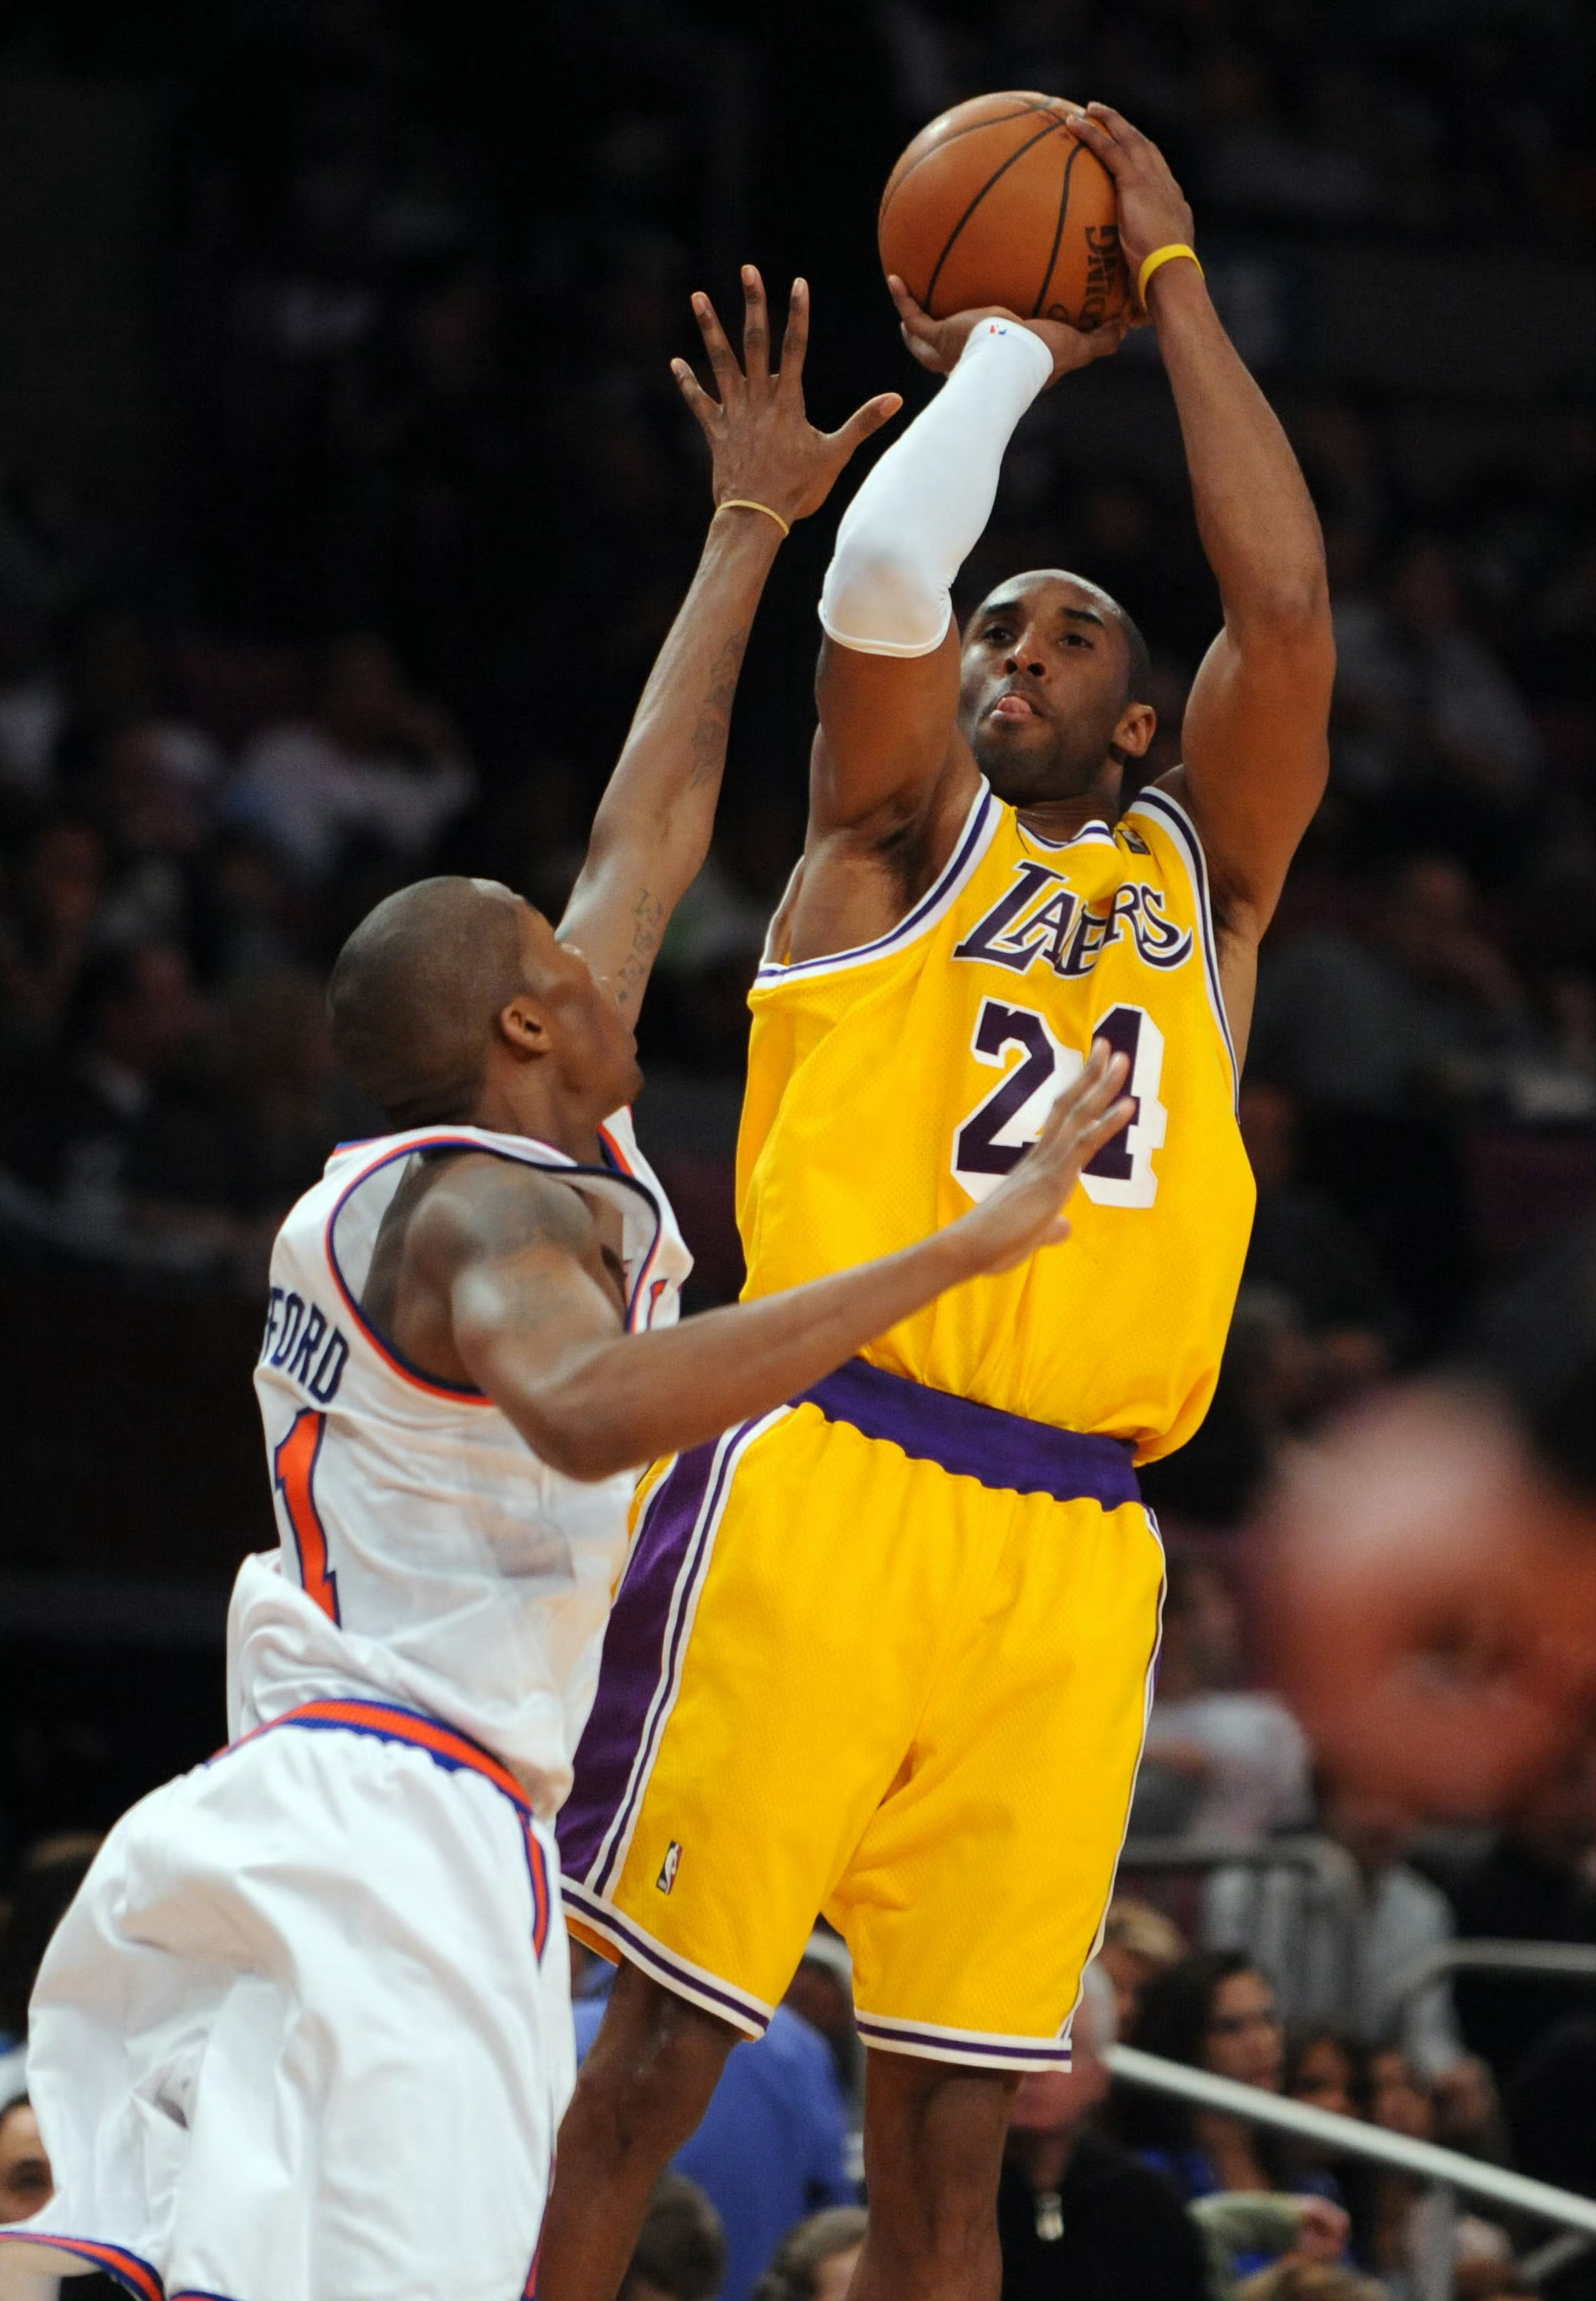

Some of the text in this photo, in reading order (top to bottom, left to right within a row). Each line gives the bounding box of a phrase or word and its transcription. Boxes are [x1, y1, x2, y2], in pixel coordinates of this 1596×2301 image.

[951, 859, 1193, 979] LAERS
[951, 995, 1168, 1209] 24
[275, 1406, 341, 1630] 1
